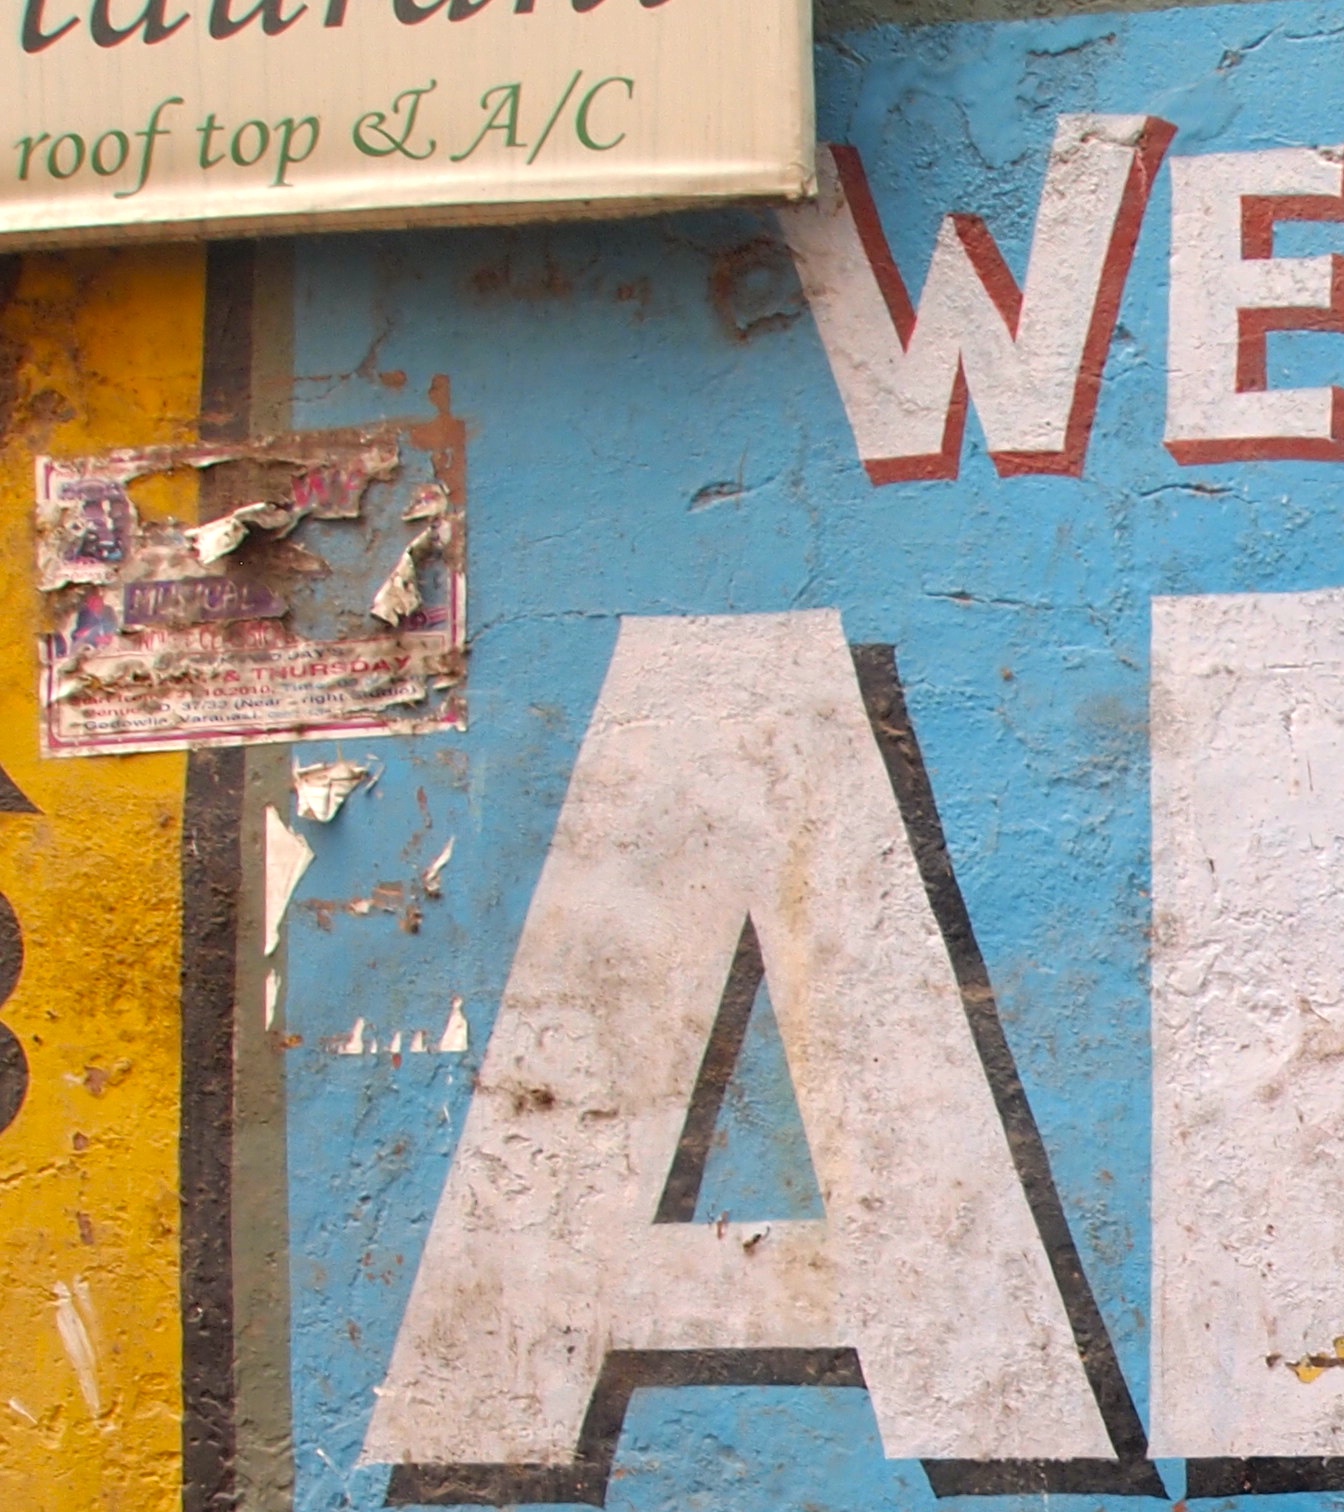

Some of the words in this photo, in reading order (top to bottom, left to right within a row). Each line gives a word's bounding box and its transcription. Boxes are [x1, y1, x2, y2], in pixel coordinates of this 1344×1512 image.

[14, 97, 184, 198] roof
[198, 112, 320, 187] top
[352, 79, 438, 161] &
[450, 69, 635, 164] A/C
[252, 653, 412, 682] THURSDAY
